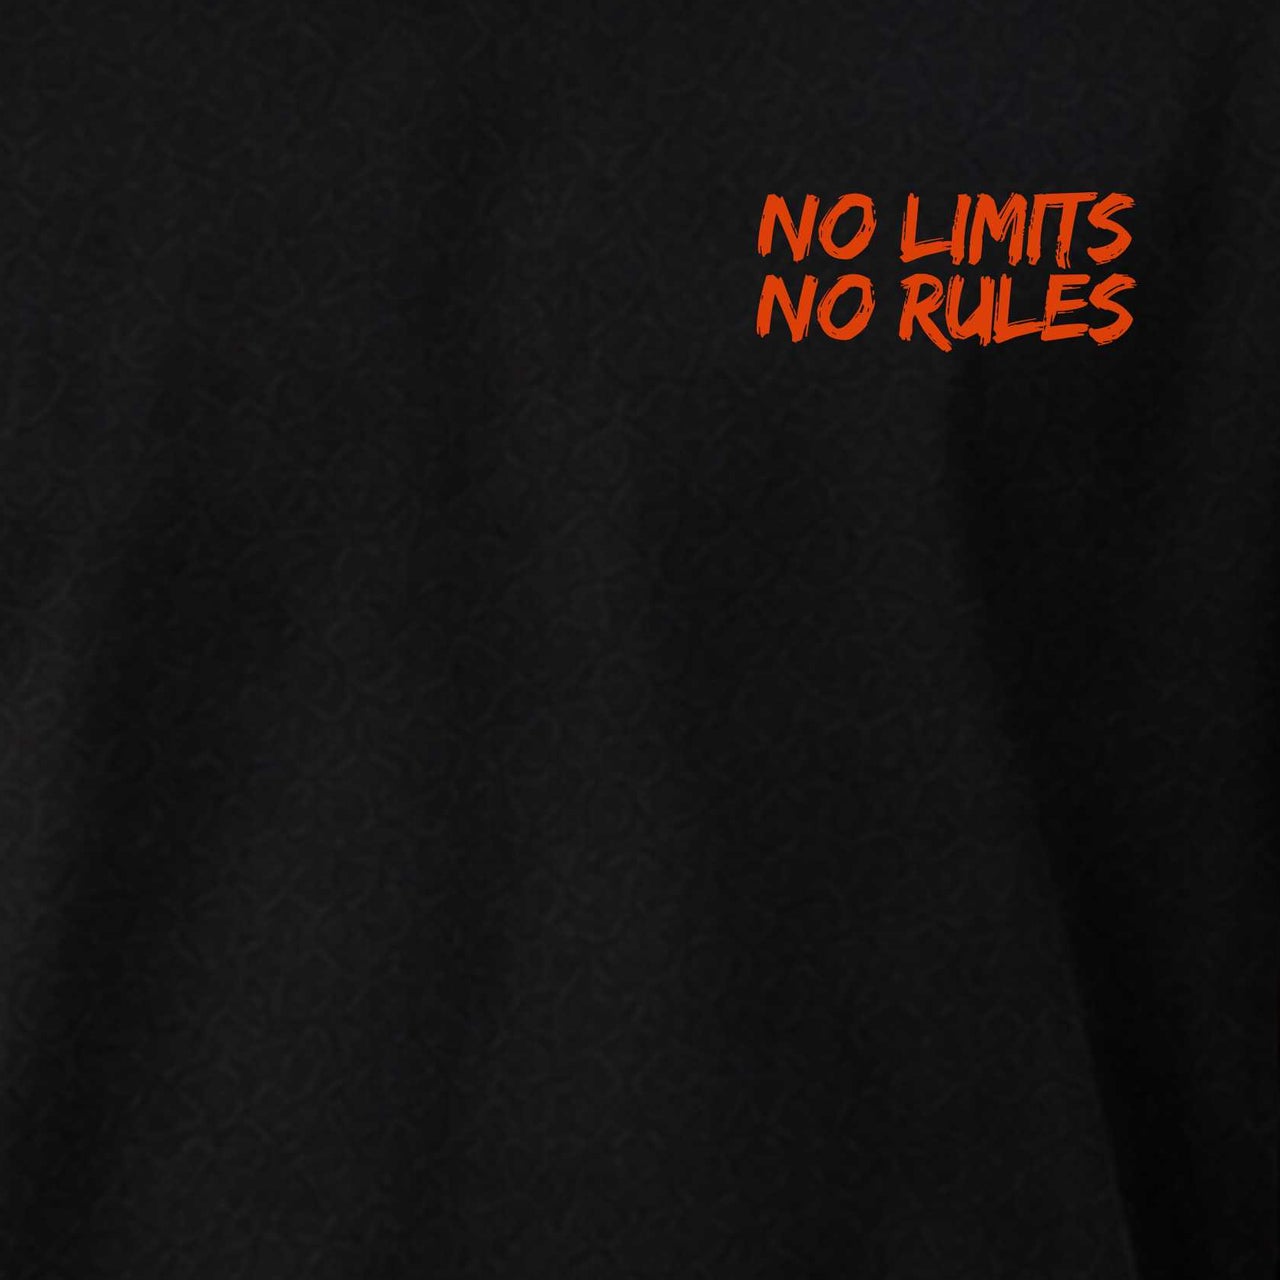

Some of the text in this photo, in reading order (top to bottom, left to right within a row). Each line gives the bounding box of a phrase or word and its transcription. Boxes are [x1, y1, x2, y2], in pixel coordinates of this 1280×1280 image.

[757, 192, 1135, 270] NO LIMITS
[756, 274, 1136, 352] NO RULES
